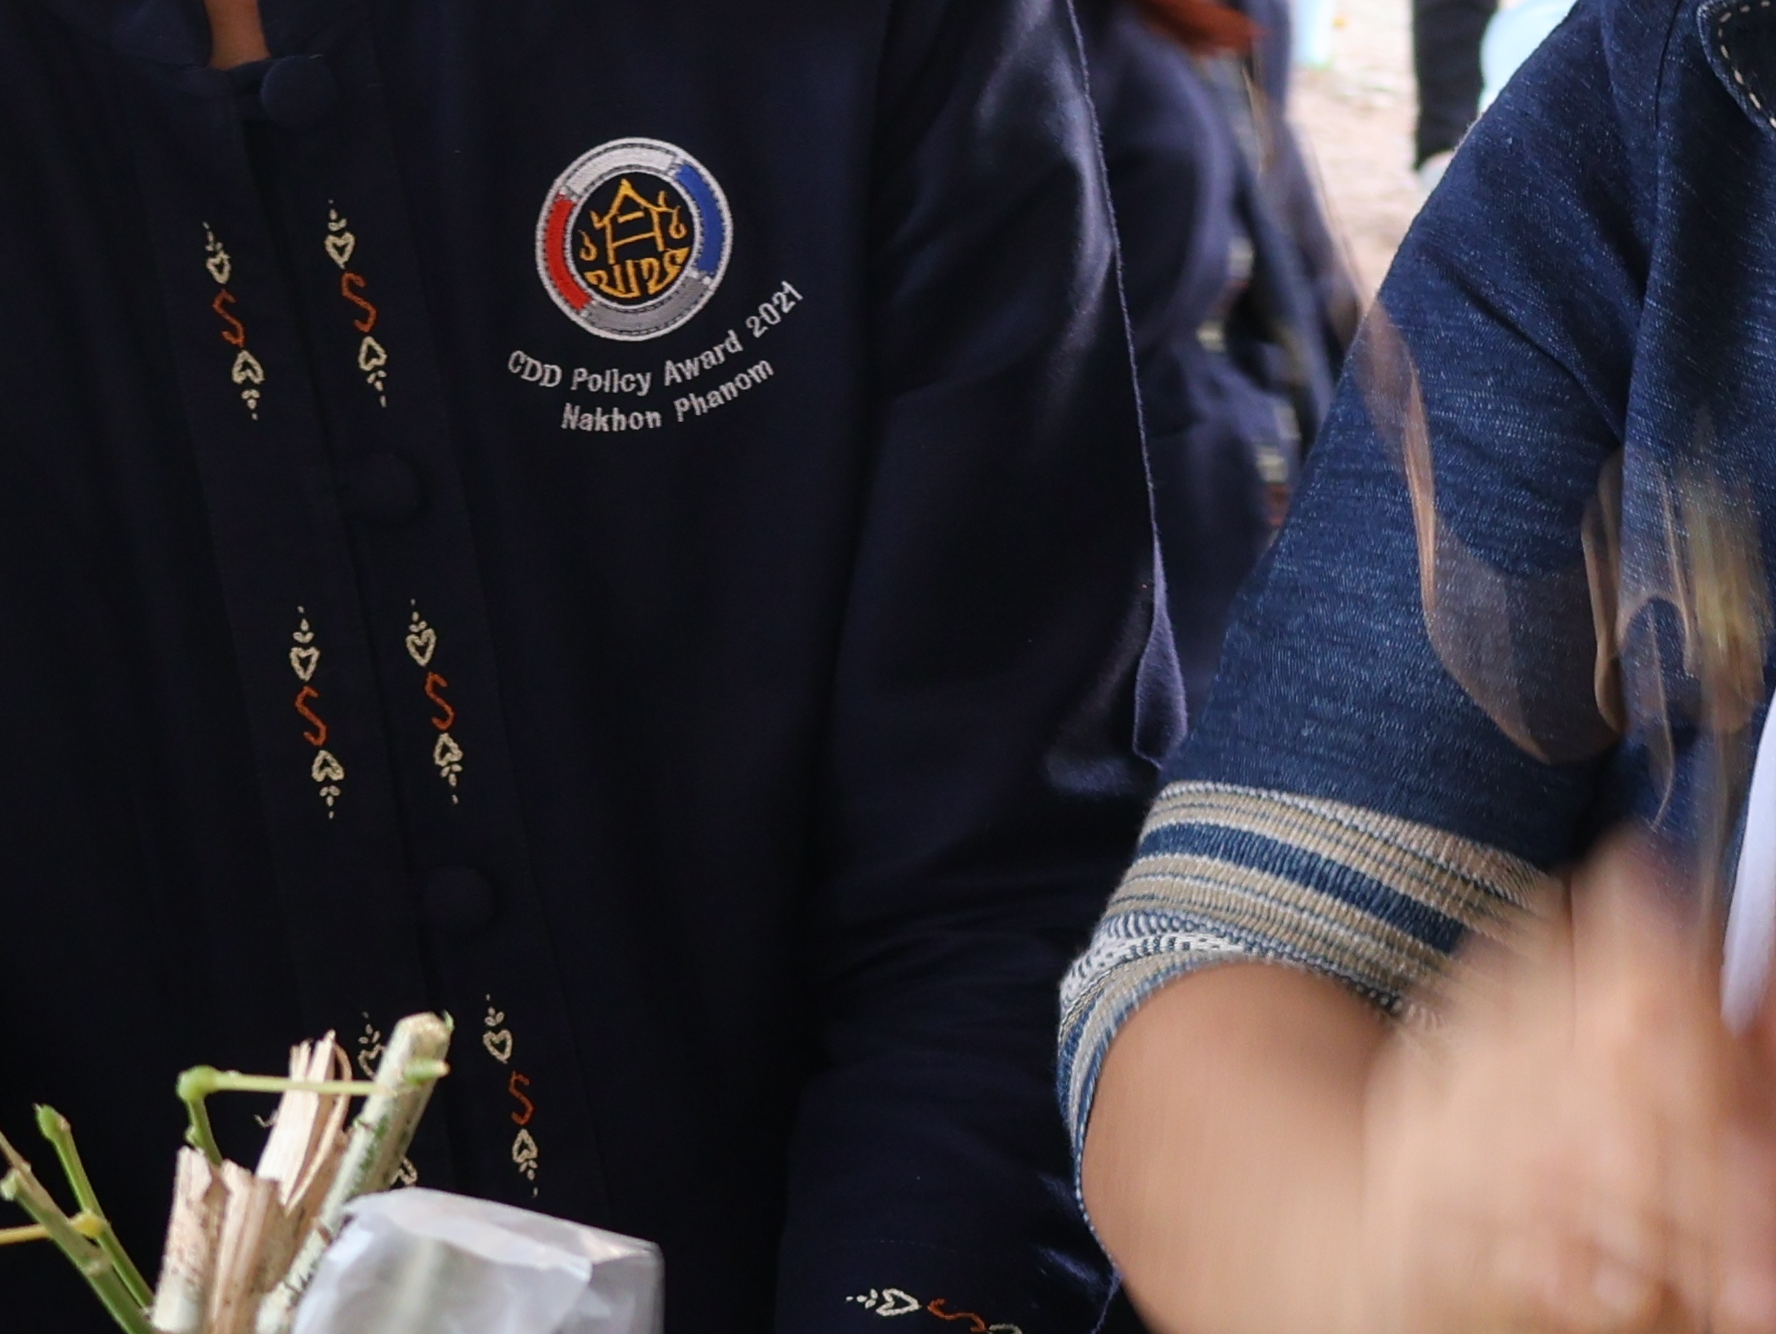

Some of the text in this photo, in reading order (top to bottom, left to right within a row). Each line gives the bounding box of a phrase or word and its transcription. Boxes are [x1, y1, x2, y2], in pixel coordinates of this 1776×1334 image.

[507, 280, 804, 396] CDD Policy Award 2021
[560, 358, 775, 432] Nakhon Phanom
